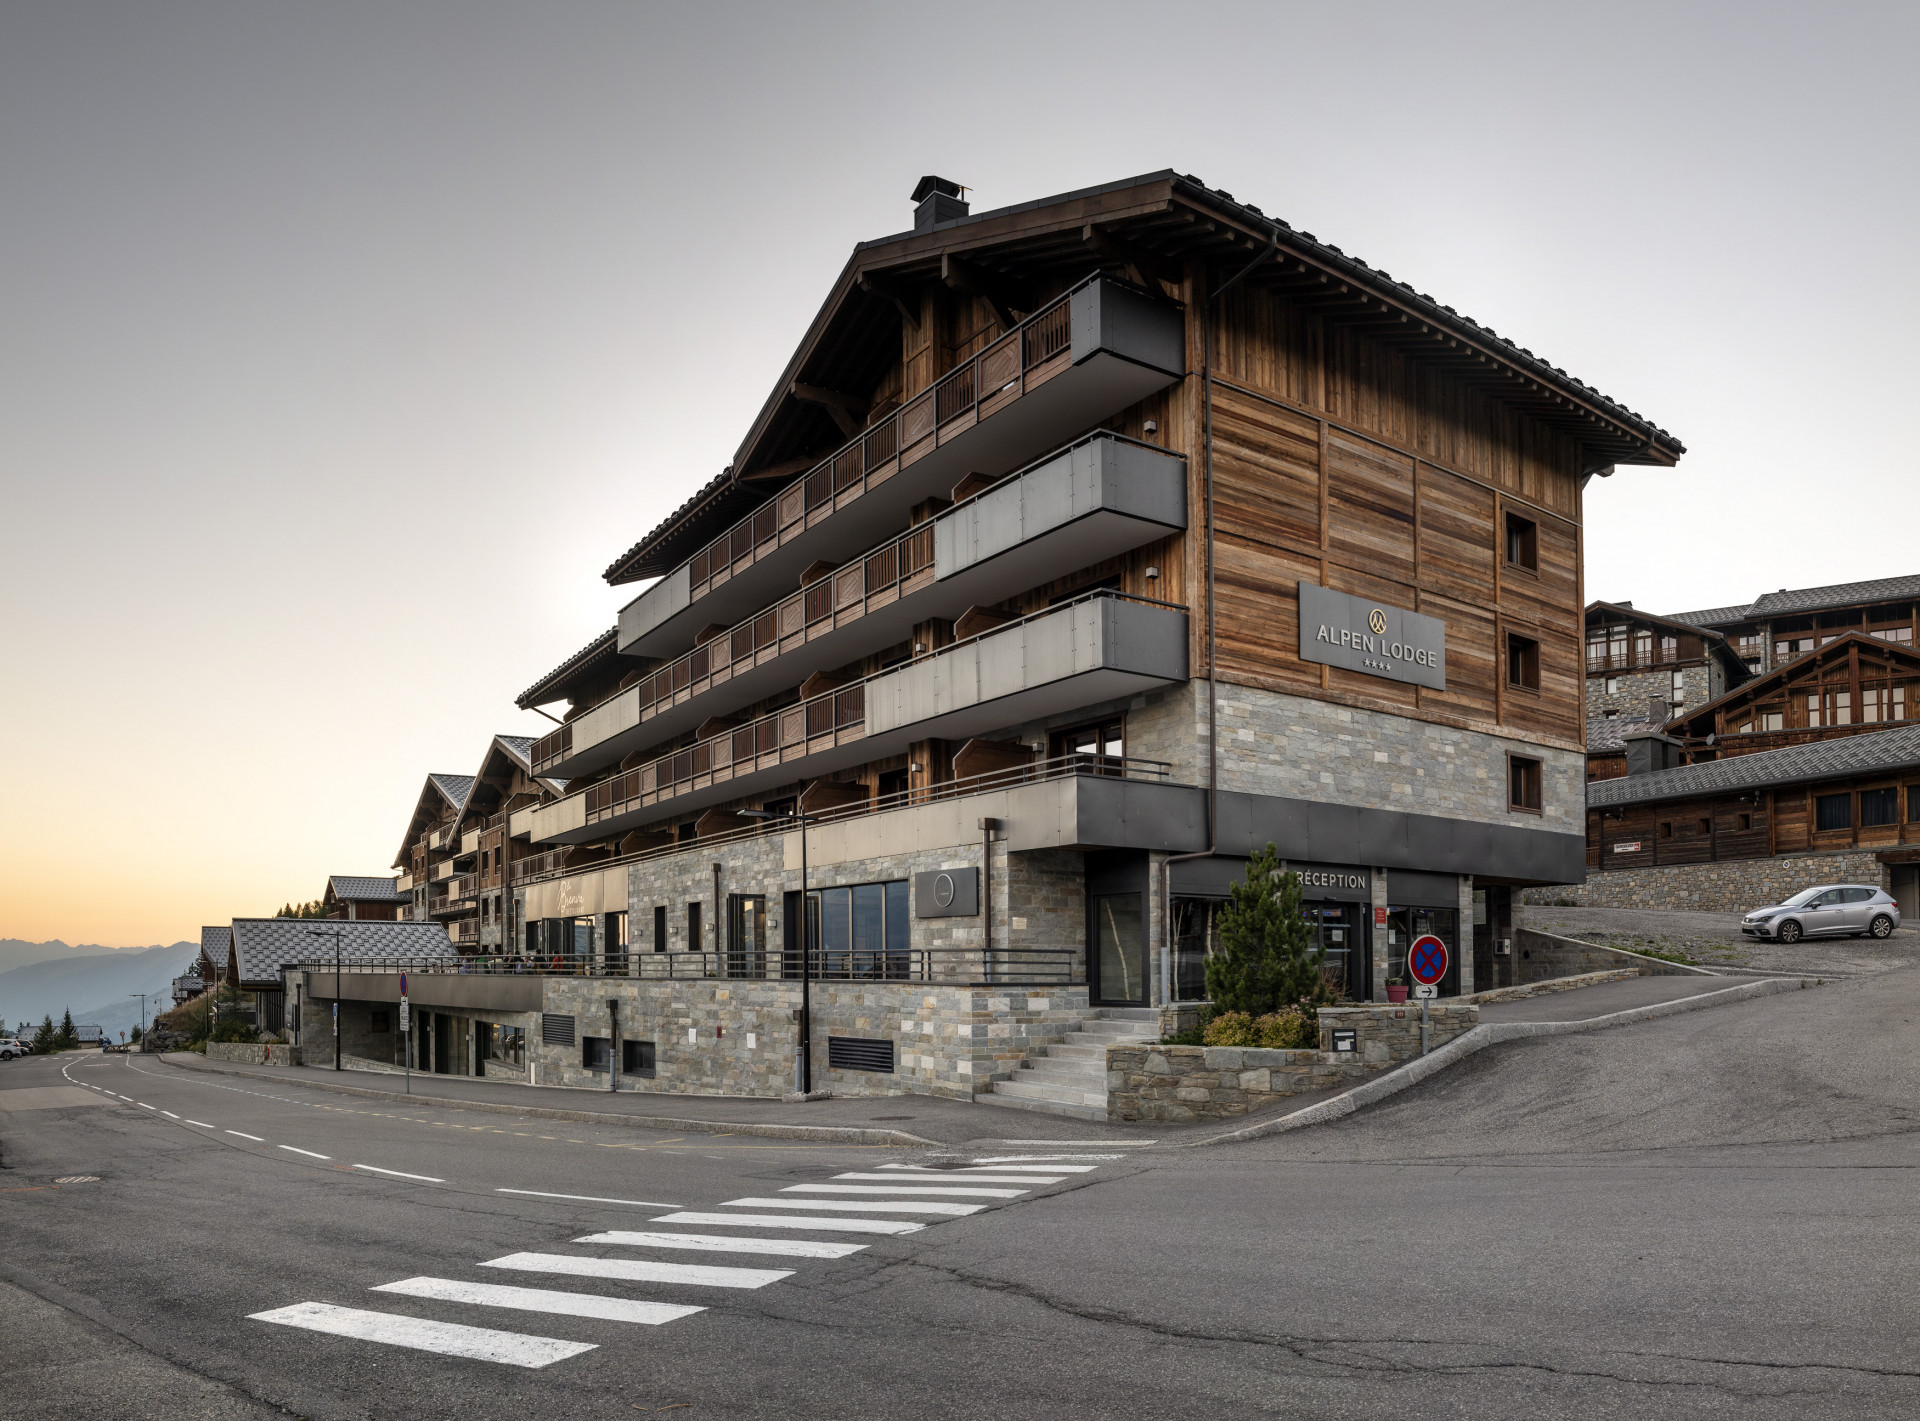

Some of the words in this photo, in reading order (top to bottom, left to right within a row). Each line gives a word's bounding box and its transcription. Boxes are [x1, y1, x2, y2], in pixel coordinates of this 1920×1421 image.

[1316, 624, 1375, 653] ALPEN
[1381, 639, 1438, 668] LODGE
[1296, 869, 1366, 889] RÉCEPTION
